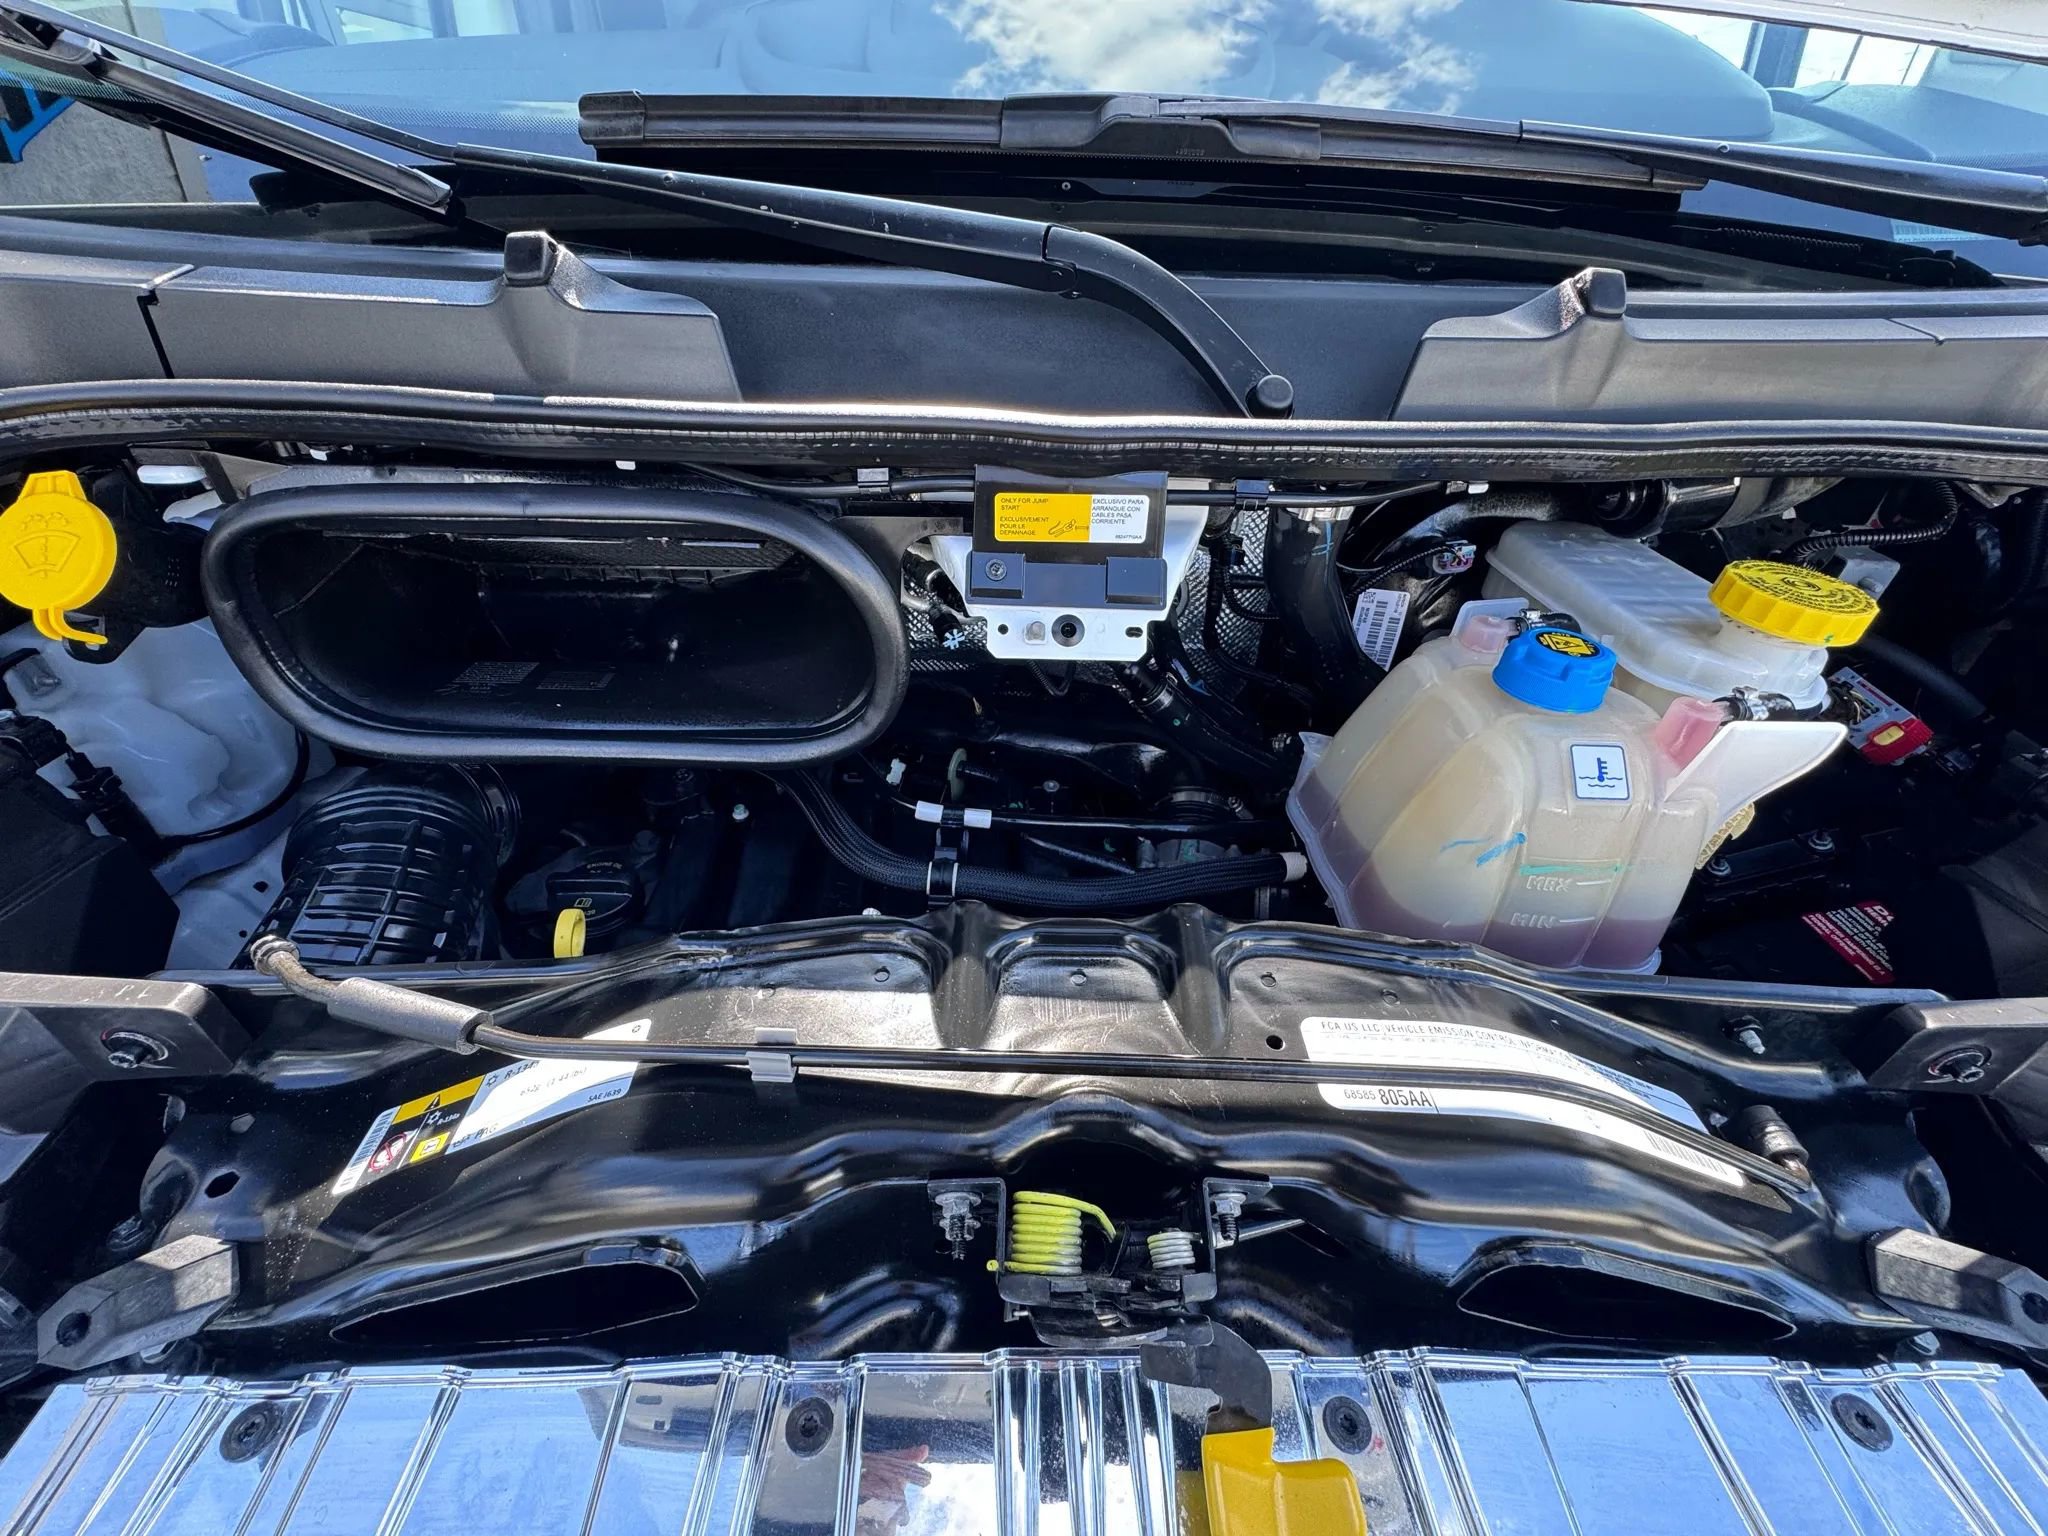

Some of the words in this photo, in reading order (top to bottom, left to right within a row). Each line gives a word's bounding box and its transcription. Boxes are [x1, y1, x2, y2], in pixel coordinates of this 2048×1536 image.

[1526, 875, 1573, 892] MAX
[1510, 912, 1557, 928] MIN
[1321, 1021, 1340, 1031] FCA
[1344, 1022, 1358, 1031] US
[1361, 1023, 1380, 1033] LLC
[1385, 1024, 1424, 1034] VEHICLE
[1427, 1025, 1474, 1038] EMISSION
[1378, 1084, 1432, 1107] 805AA
